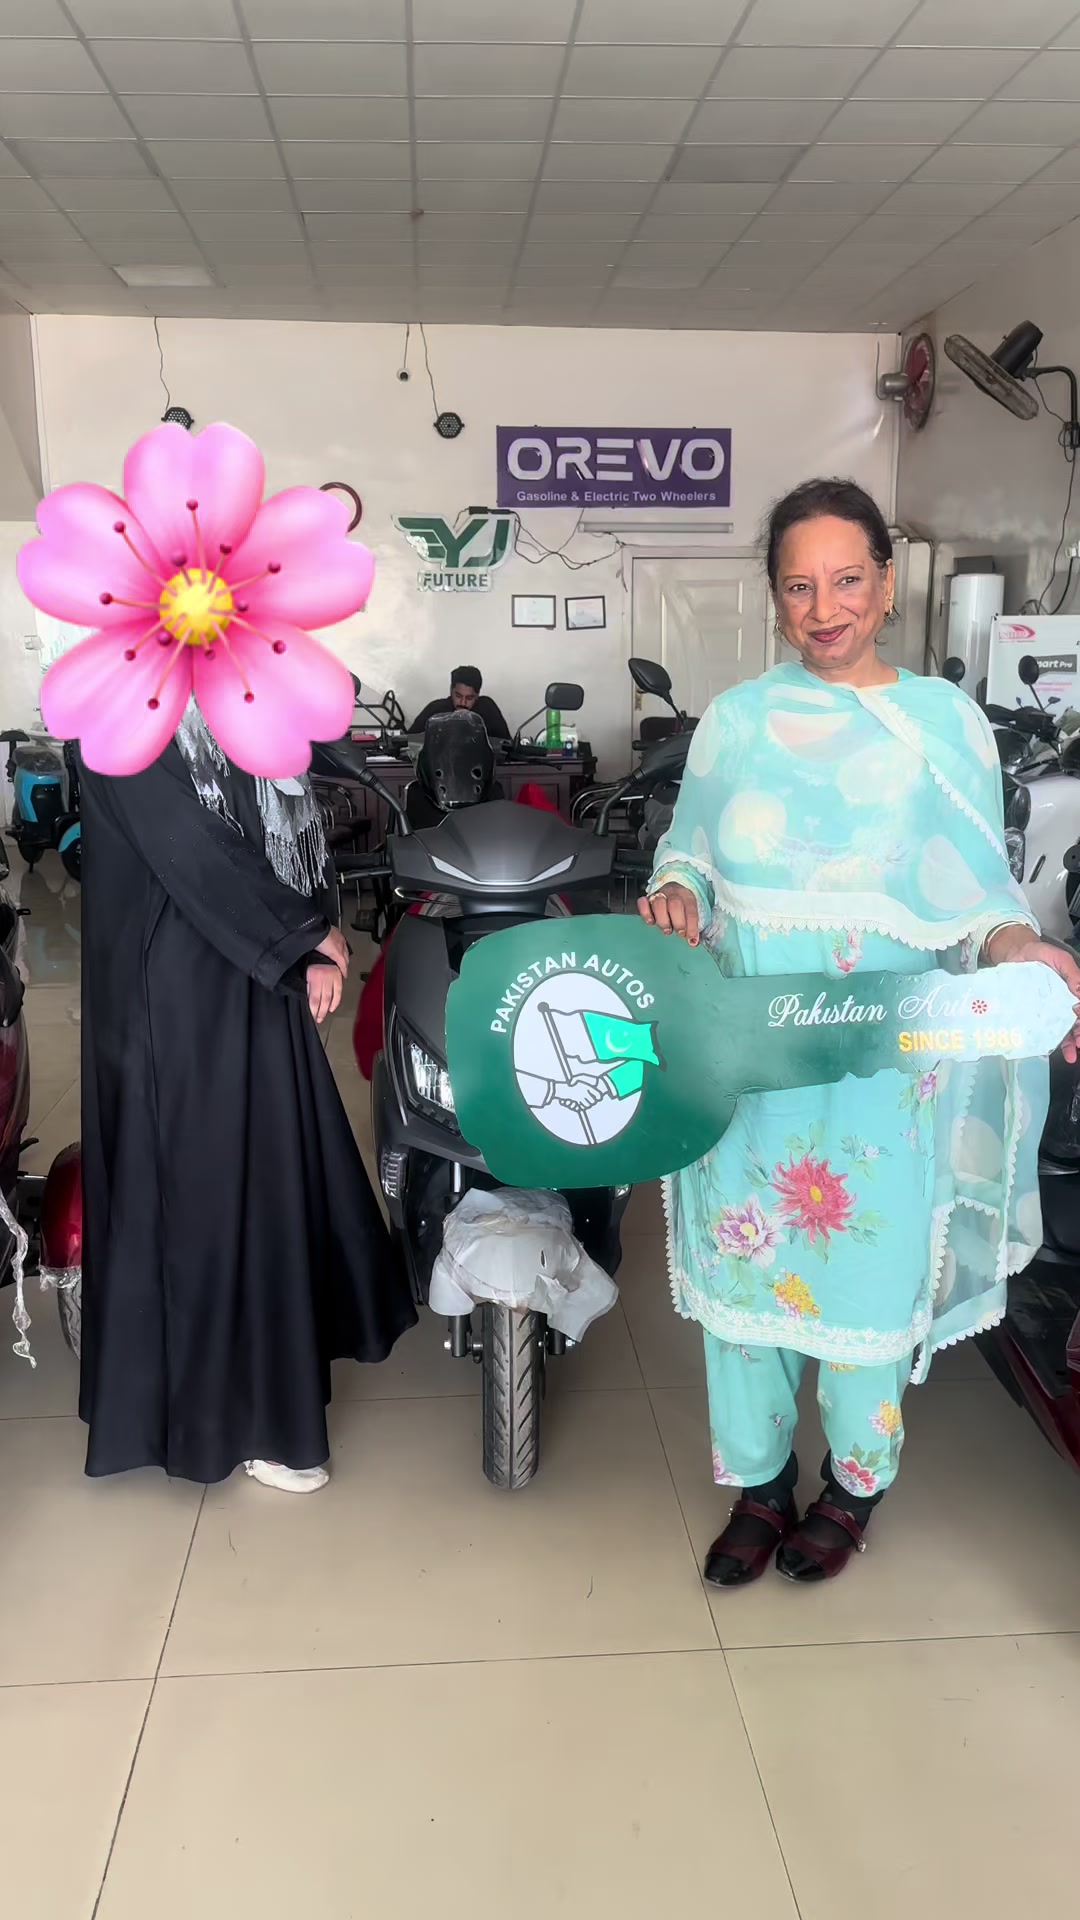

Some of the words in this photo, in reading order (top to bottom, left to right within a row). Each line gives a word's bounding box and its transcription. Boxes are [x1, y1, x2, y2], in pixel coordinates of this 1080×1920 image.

[507, 437, 725, 481] OREVO
[516, 491, 567, 501] Gasoline
[571, 491, 580, 501] &
[584, 491, 629, 502] Electric
[632, 491, 656, 501] Two
[660, 491, 716, 501] Wheelers
[423, 573, 488, 587] FUTURE
[490, 951, 577, 1033] PAKISTAN
[583, 954, 655, 1009] AUTOS
[767, 991, 887, 1027] Pakistan
[898, 1029, 964, 1052] SINCE
